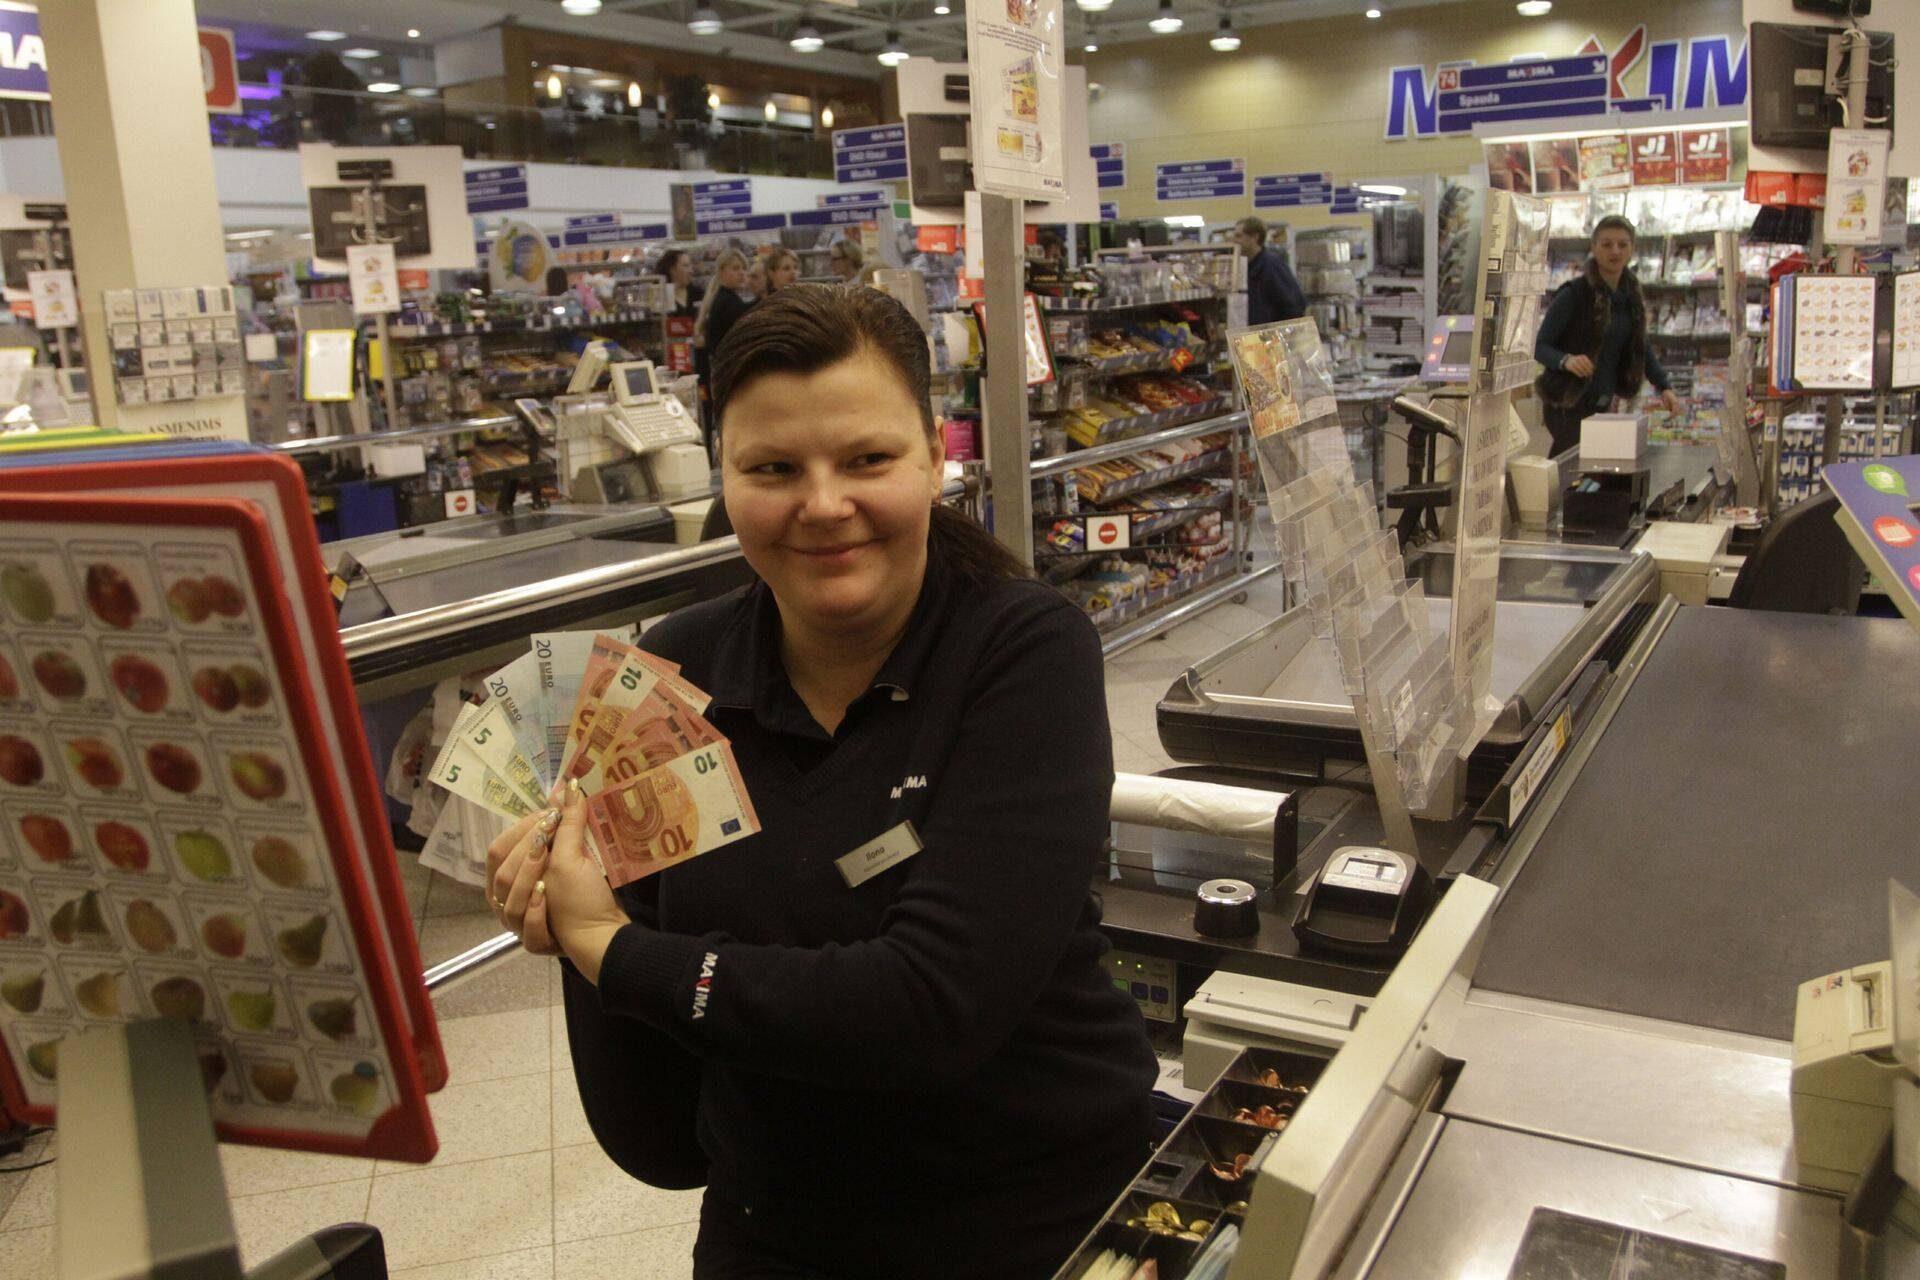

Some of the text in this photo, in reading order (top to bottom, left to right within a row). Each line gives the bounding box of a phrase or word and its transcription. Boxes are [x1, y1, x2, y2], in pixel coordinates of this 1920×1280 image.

[1440, 70, 1457, 89] 74
[1506, 64, 1555, 80] MAXIMA
[536, 639, 552, 659] 20
[543, 661, 554, 688] EURO
[620, 666, 642, 691] 10
[490, 677, 509, 698] 20
[505, 696, 522, 721] EURO
[474, 727, 492, 745] 5
[446, 764, 461, 783] 5
[513, 753, 531, 774] EURO
[605, 756, 639, 786] 10
[694, 751, 718, 775] 10
[488, 779, 507, 794] EURO
[660, 824, 694, 858] 10
[692, 952, 719, 1020] MAXIMA
